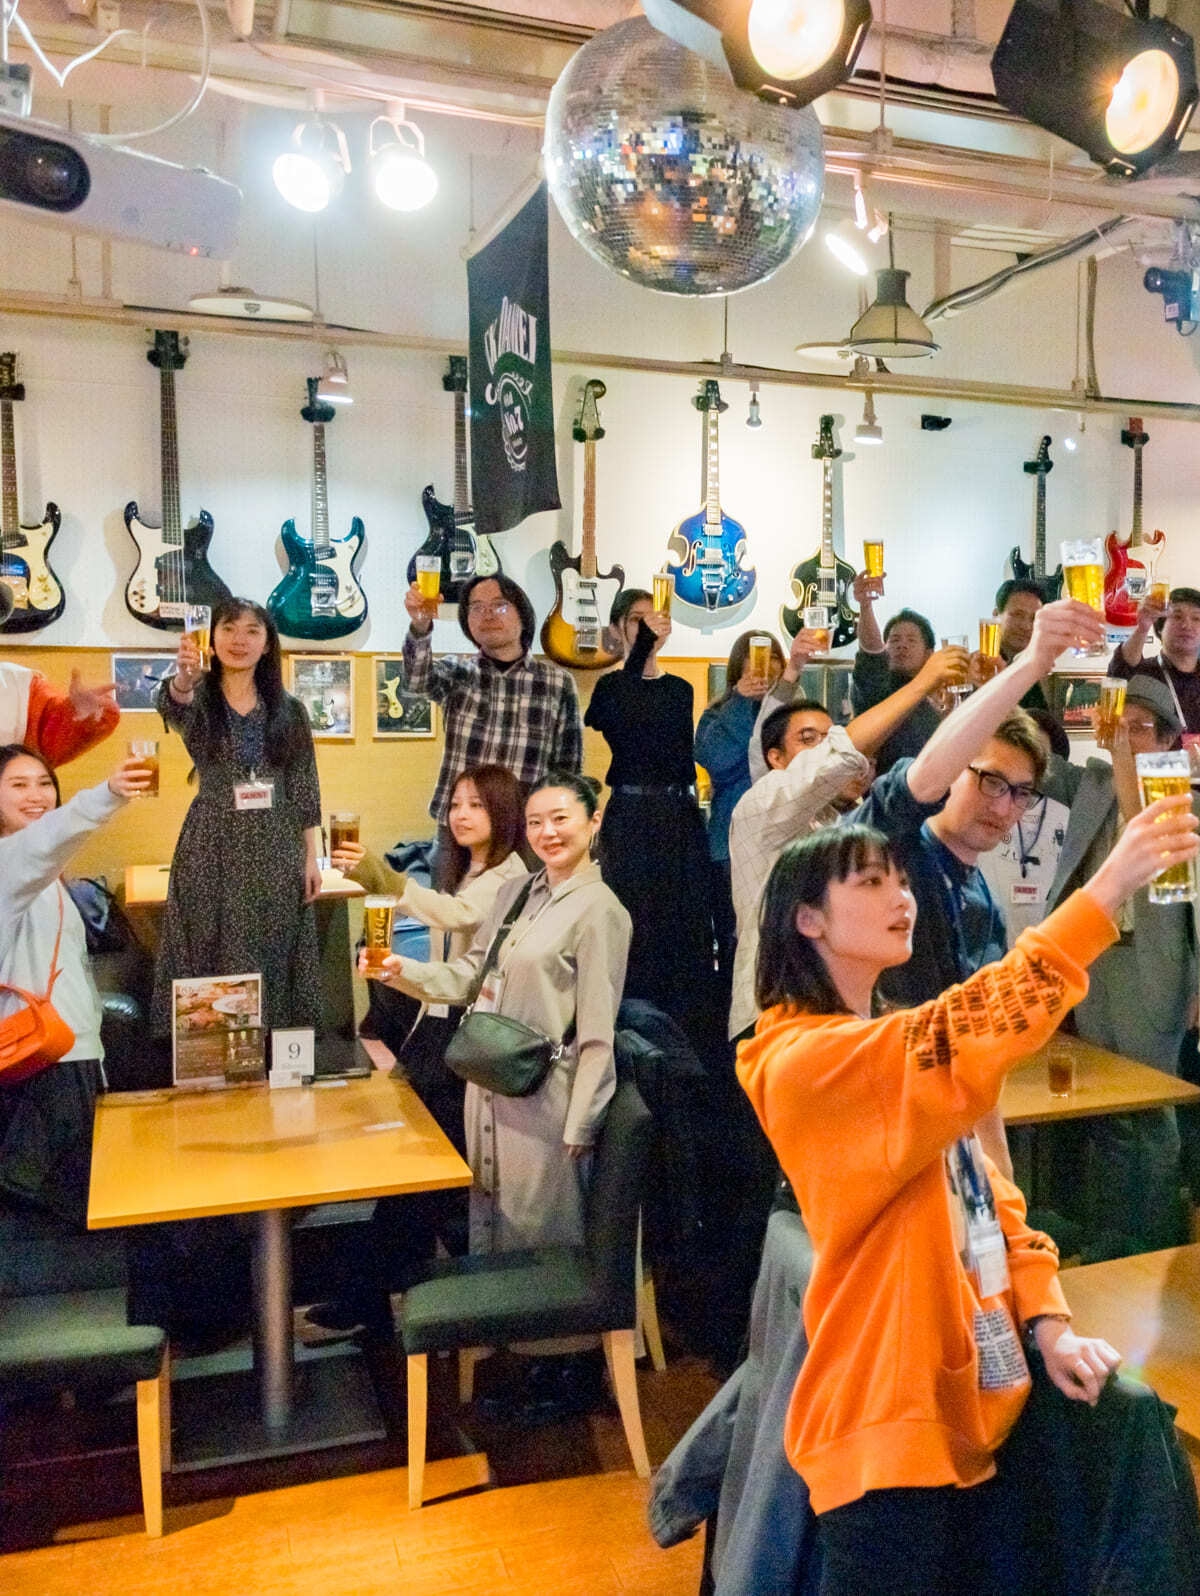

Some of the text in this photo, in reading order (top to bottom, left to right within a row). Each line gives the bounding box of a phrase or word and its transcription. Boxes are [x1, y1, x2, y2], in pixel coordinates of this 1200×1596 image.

[1000, 981, 1030, 1035] WAITING
[1019, 987, 1040, 1010] WE
[951, 1016, 971, 1038] WE
[972, 1015, 992, 1038] THE
[288, 1041, 301, 1060] 9
